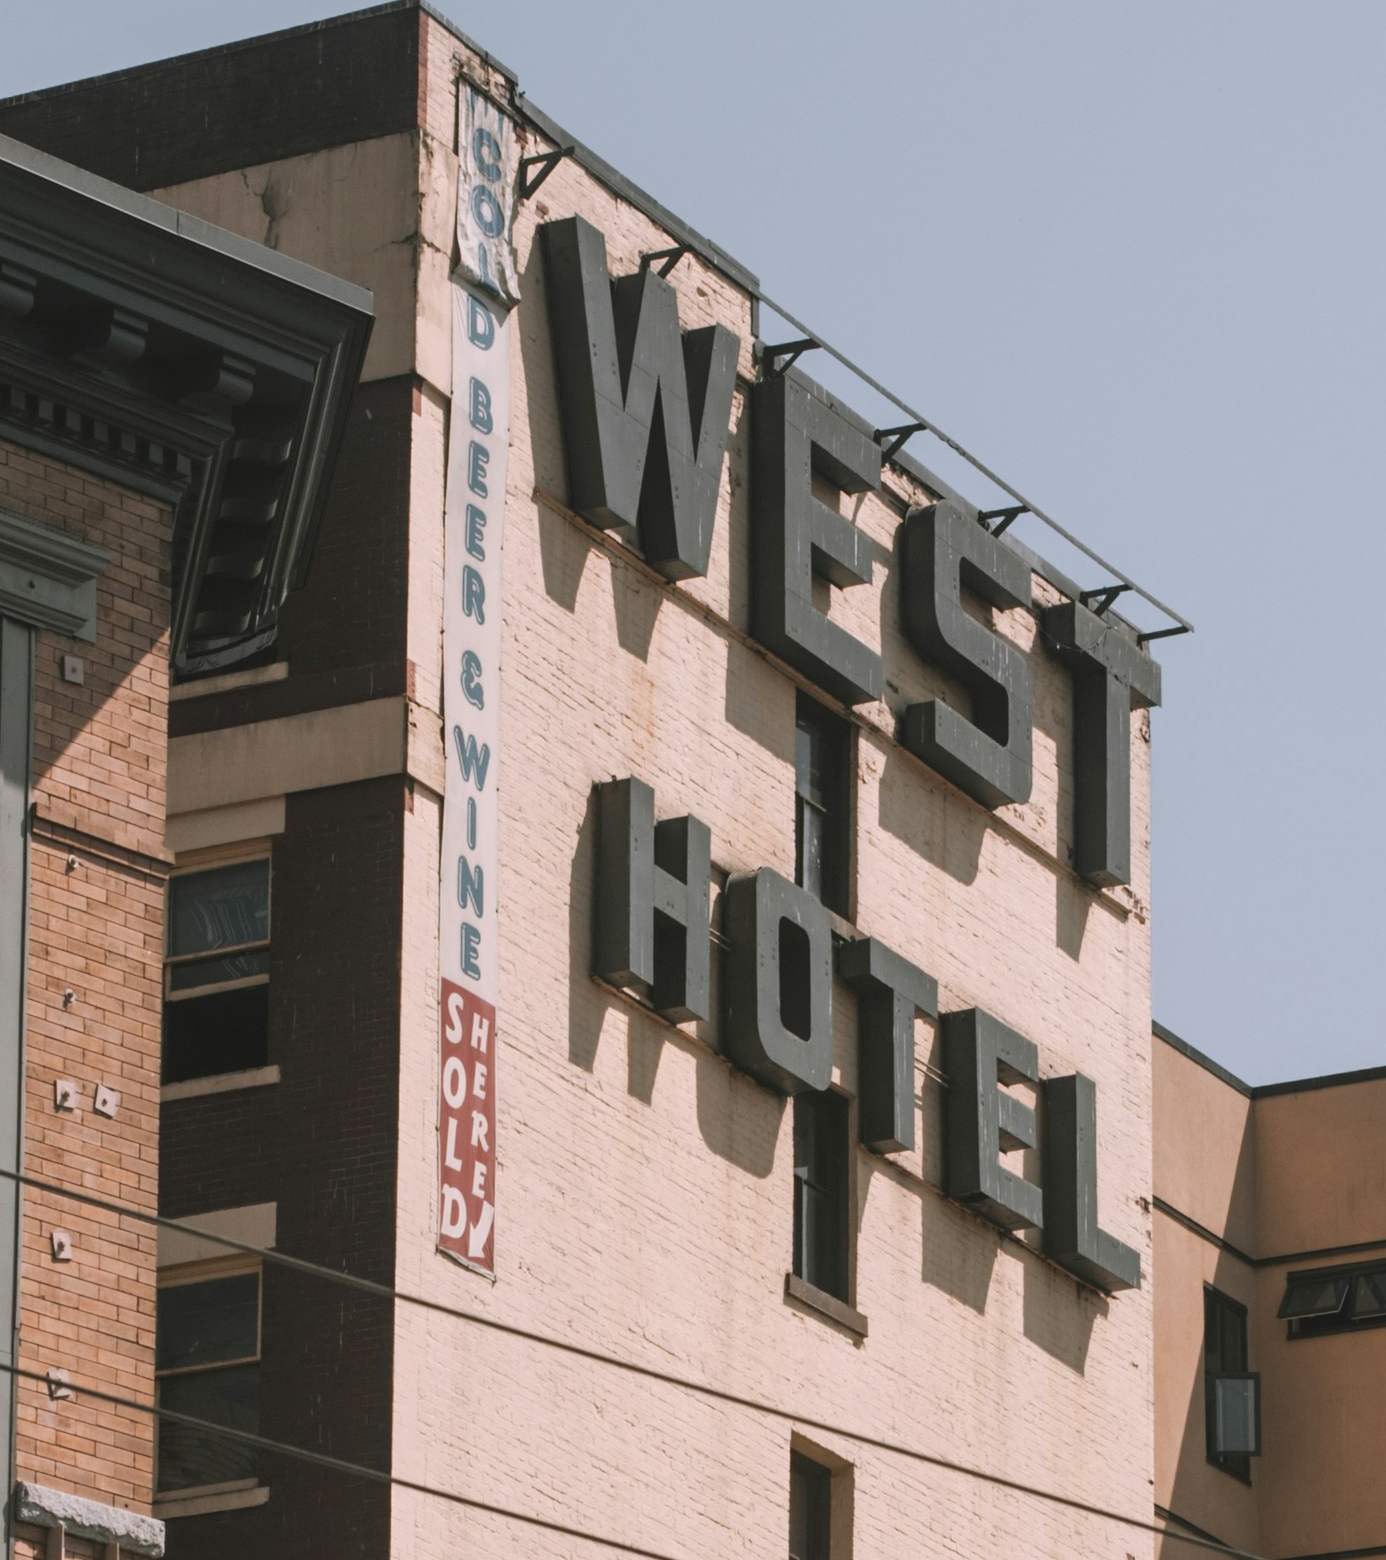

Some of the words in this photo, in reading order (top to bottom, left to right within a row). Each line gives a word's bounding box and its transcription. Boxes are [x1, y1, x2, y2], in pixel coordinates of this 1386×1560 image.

[463, 376, 493, 626] BEER
[535, 214, 1163, 888] WEST
[461, 650, 485, 711] &
[454, 725, 490, 981] WINE
[440, 992, 467, 1239] SOLD
[470, 1012, 490, 1200] HERE
[593, 776, 1142, 1297] HOTEL
